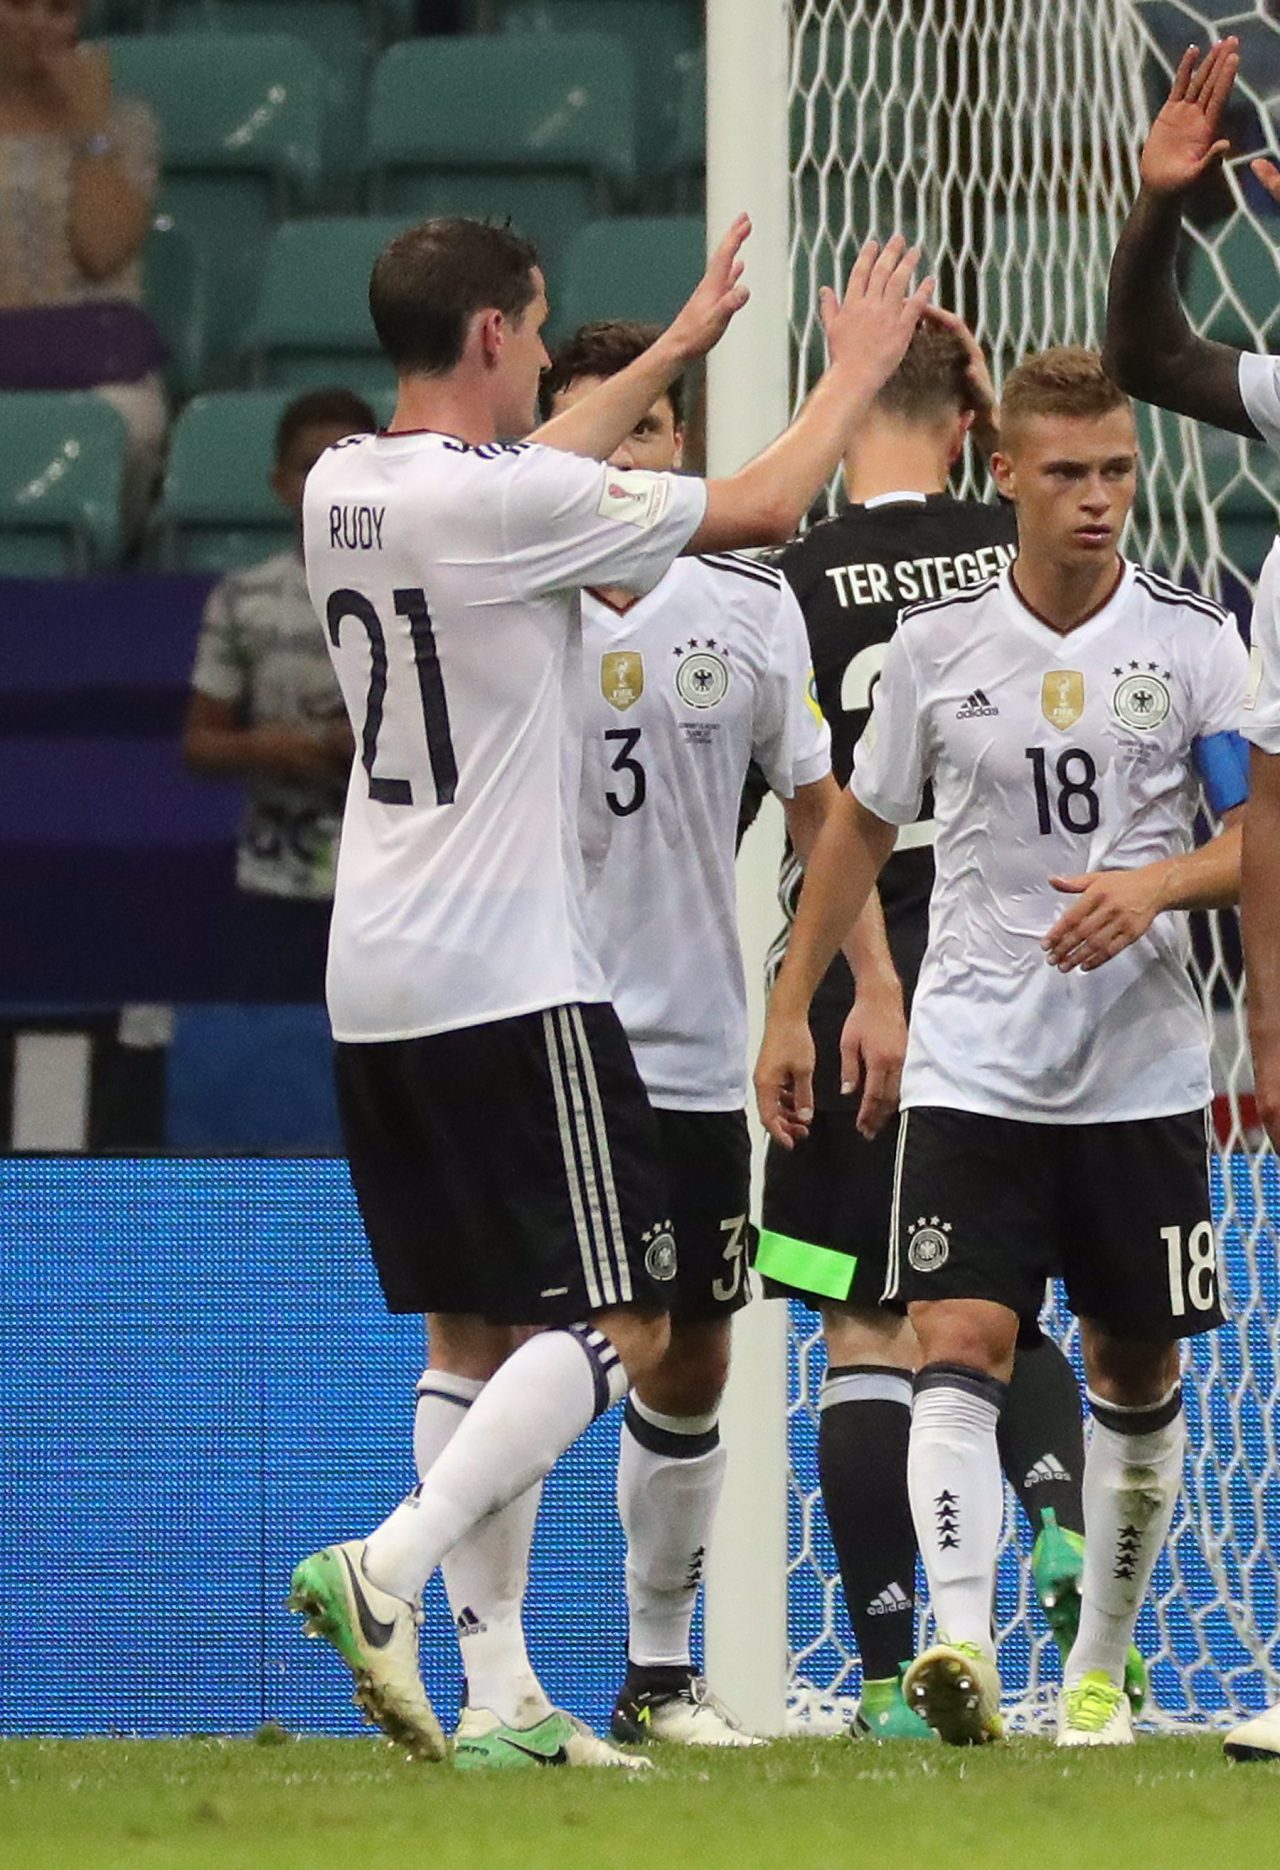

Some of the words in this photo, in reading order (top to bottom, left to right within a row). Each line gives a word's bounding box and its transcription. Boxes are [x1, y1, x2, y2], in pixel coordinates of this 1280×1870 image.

[330, 505, 385, 549] RUDY
[825, 564, 893, 607] TER
[327, 588, 458, 806] 21
[956, 706, 999, 720] adidas
[604, 728, 646, 817] 3
[1025, 747, 1100, 835] 18
[712, 1213, 745, 1301] 3
[1160, 1220, 1217, 1316] 18
[1024, 1471, 1071, 1488] adidas
[866, 1599, 913, 1616] adidas
